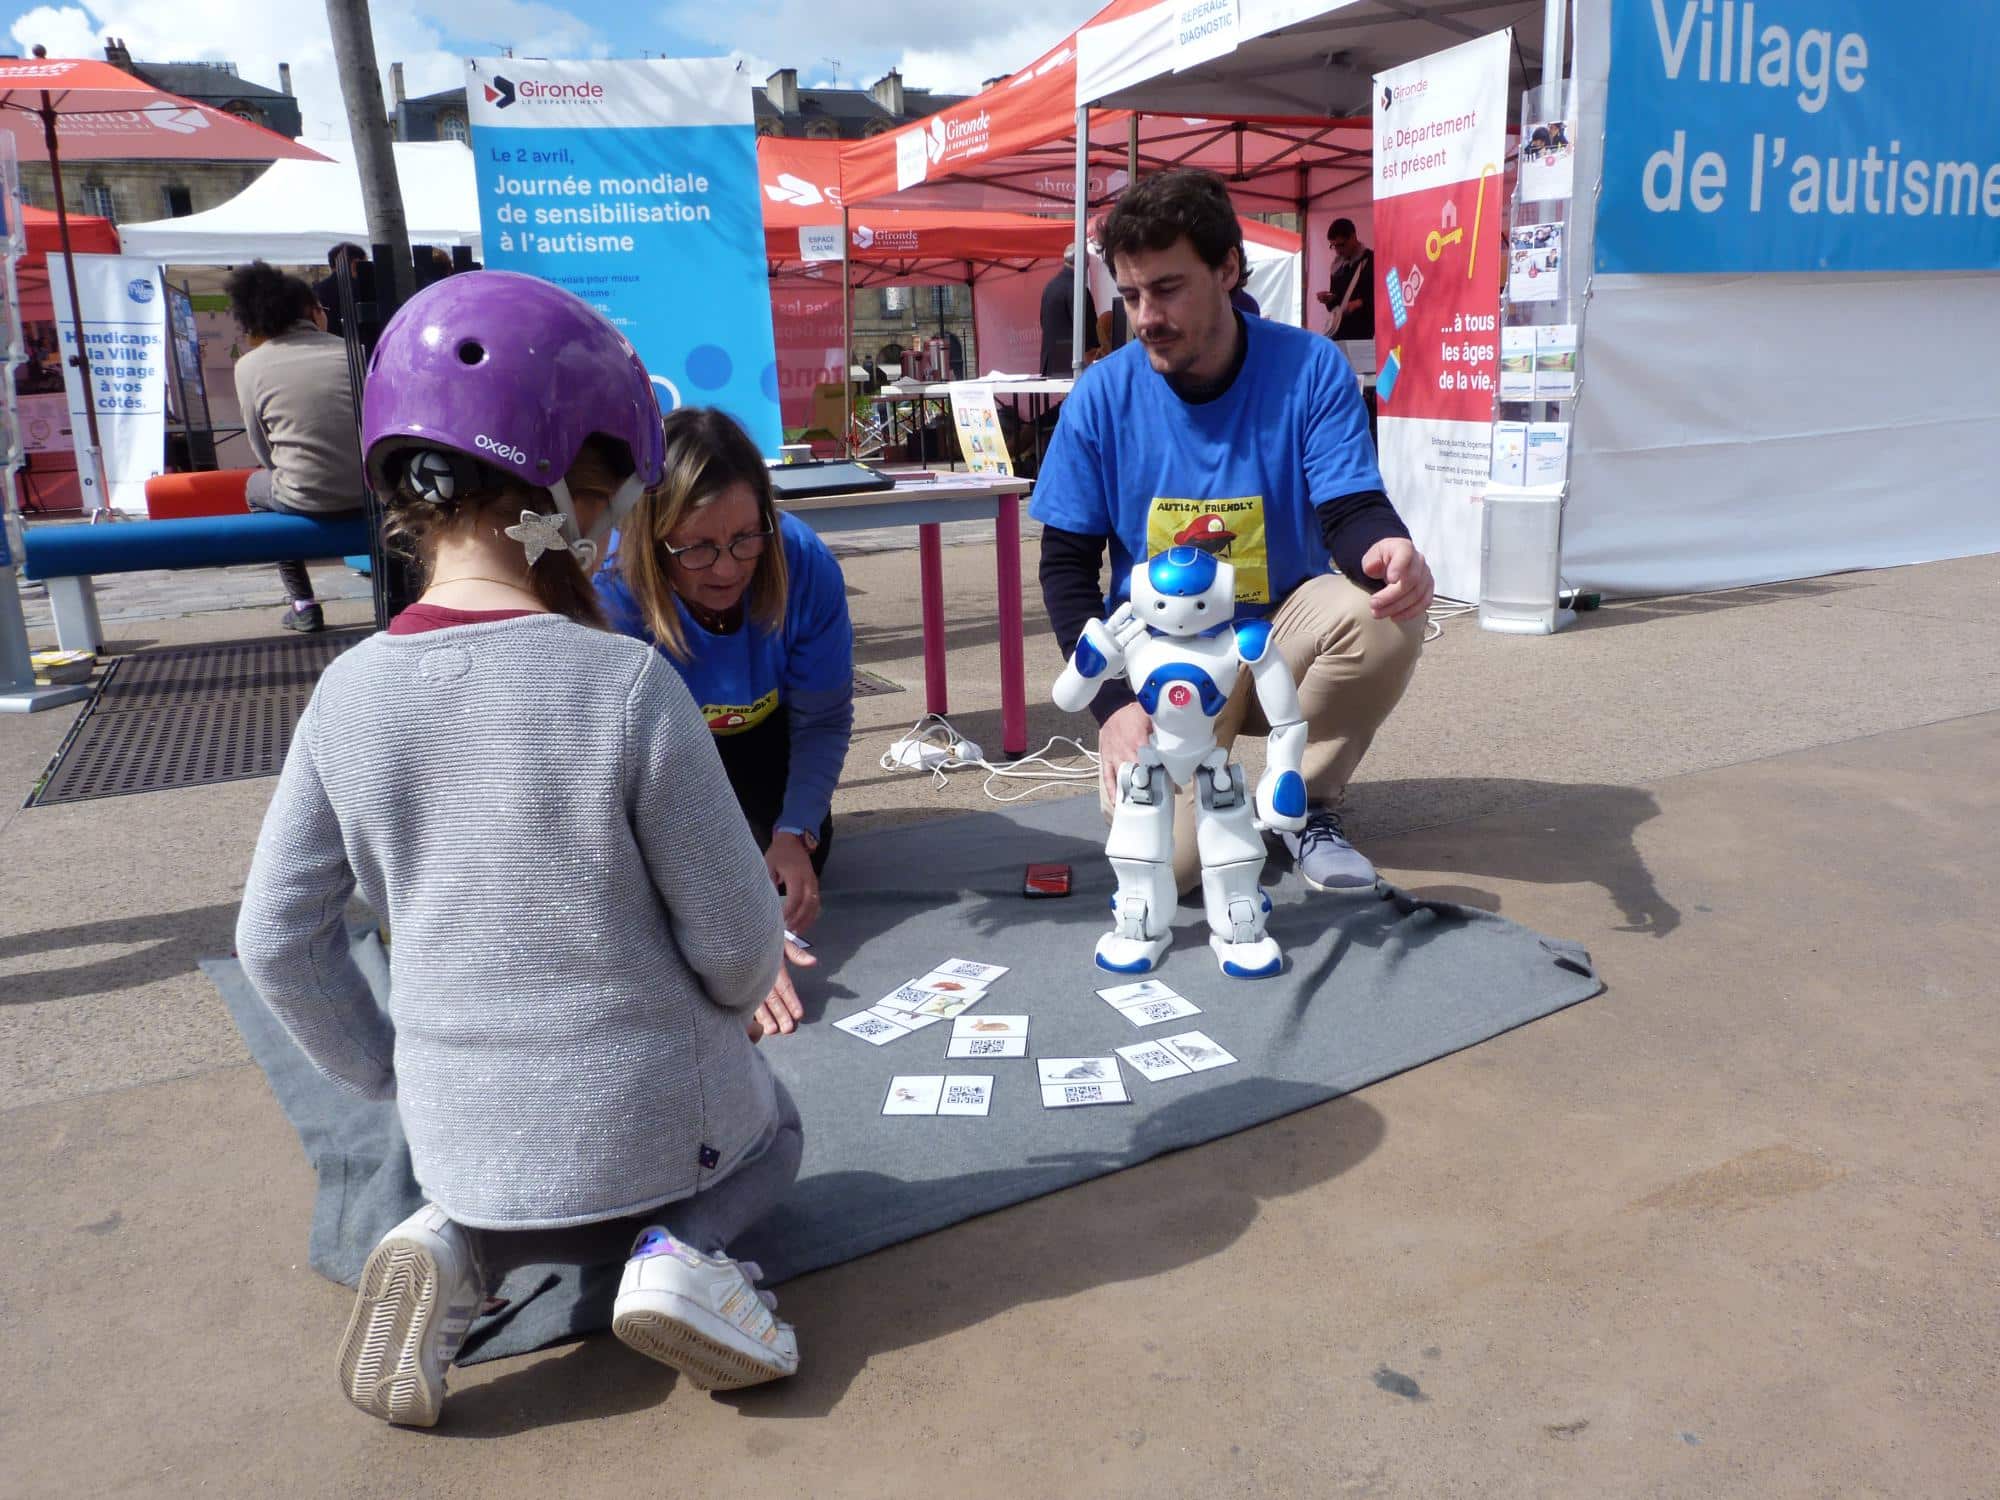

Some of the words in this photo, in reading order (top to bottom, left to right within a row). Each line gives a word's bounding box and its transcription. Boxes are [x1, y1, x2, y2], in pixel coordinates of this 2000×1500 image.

[1180, 12, 1232, 45] DIAGNOSTIC
[1651, 0, 1869, 113] Village
[519, 80, 603, 97] Gironde
[1393, 79, 1428, 99] Gironde
[946, 110, 991, 140] Gironde
[1383, 136, 1393, 151] Le
[1396, 110, 1476, 149] Département
[491, 148, 511, 162] Le
[517, 148, 528, 162] 2
[532, 148, 574, 164] avril,
[1382, 160, 1398, 179] est
[1401, 148, 1447, 180] présent
[1642, 130, 1728, 213] de
[494, 175, 592, 196] Journée
[600, 173, 709, 194] mondiale
[497, 203, 528, 223] de
[535, 202, 711, 224] sensibilisation
[500, 232, 514, 251] à
[808, 235, 834, 243] ESPACE
[875, 230, 918, 240] Gironde
[810, 243, 833, 252] CALME
[1465, 313, 1495, 331] tous
[88, 348, 104, 360] la
[109, 348, 148, 361] Ville
[1442, 342, 1460, 361] les
[1462, 341, 1494, 366] âges
[101, 381, 110, 392] à
[114, 383, 143, 392] vos
[1439, 370, 1454, 389] de
[1457, 370, 1468, 389] la
[1470, 370, 1494, 390] vie.
[475, 434, 527, 465] oxelo
[1157, 502, 1200, 513] AUTISM
[1205, 501, 1254, 512] FRIENDLY
